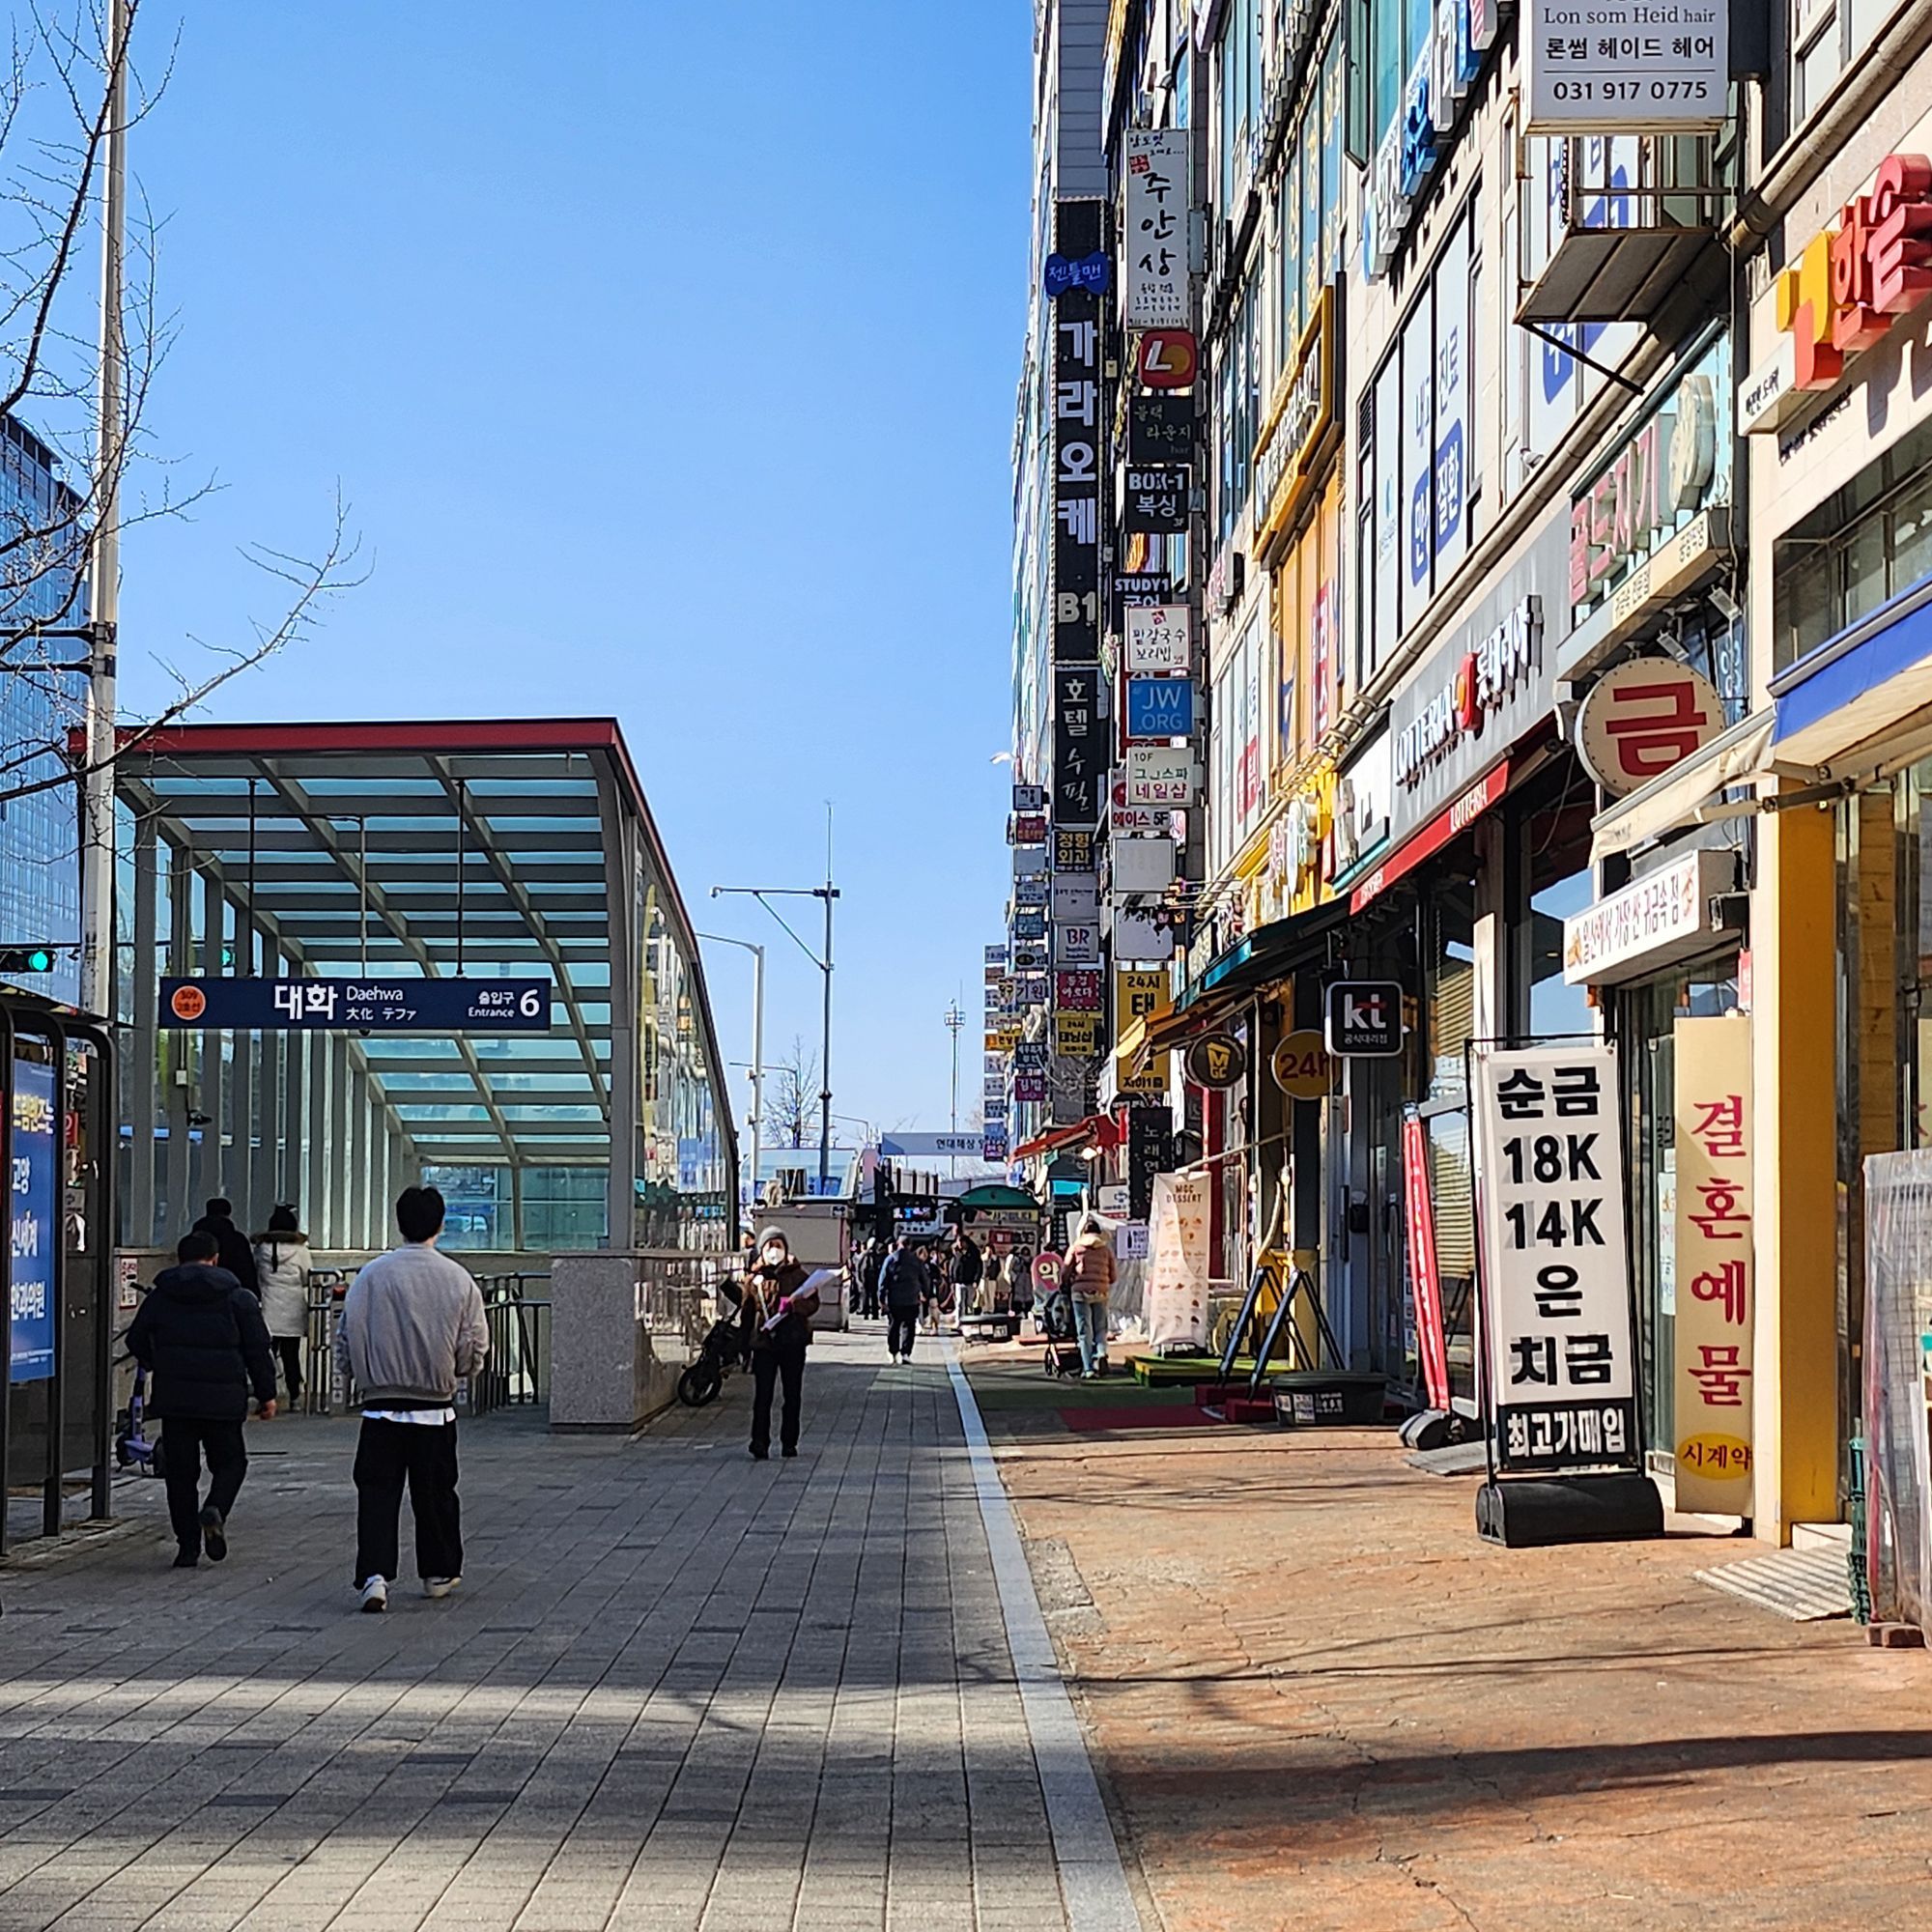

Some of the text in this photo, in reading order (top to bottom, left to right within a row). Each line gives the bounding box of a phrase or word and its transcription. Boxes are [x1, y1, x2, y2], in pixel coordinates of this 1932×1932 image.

[1544, 6, 1716, 24] Lon som Heid hair
[1546, 36, 1714, 60] 론썸 헤이드 헤어
[1553, 80, 1708, 100] 031 917 0775
[1139, 172, 1178, 277] 주안상
[1048, 262, 1101, 286] 젠틀맨
[1057, 320, 1098, 545] 가라오케
[1146, 423, 1191, 441] 라운지
[1128, 472, 1184, 491] BOX-1
[1135, 494, 1177, 518] 복싱
[1114, 578, 1170, 592] STUDY1
[1057, 591, 1096, 624] B1
[1063, 678, 1089, 737] 호텔
[1142, 686, 1182, 710] JW
[1605, 680, 1708, 776] 금
[1133, 753, 1153, 762] 10F
[1135, 783, 1187, 800] 네일샵
[1450, 779, 1489, 833] LOTTERIA
[1113, 811, 1151, 828] 에이스
[1058, 849, 1090, 865] 외과
[1065, 928, 1090, 945] BR
[346, 985, 404, 1002] Daehwa
[1126, 975, 1160, 989] 24시
[274, 983, 338, 1021] 대화
[478, 991, 515, 1006] 출입구
[520, 988, 541, 1017] 6
[346, 1008, 374, 1021] 大化
[382, 1008, 417, 1021] テファ
[468, 1007, 515, 1017] Entrance
[1344, 993, 1387, 1030] kt
[1344, 1033, 1388, 1045] 공식대리점
[1496, 1065, 1601, 1120] 순금
[1502, 1132, 1603, 1184] 18K
[1504, 1198, 1606, 1250] 14K
[1688, 1094, 1752, 1406] 결혼예물
[1038, 1261, 1061, 1284] 약
[1534, 1264, 1583, 1319] 은
[1509, 1333, 1613, 1386] 치금
[1507, 1407, 1627, 1458] 최고가매입
[1683, 1441, 1753, 1471] 시계약
